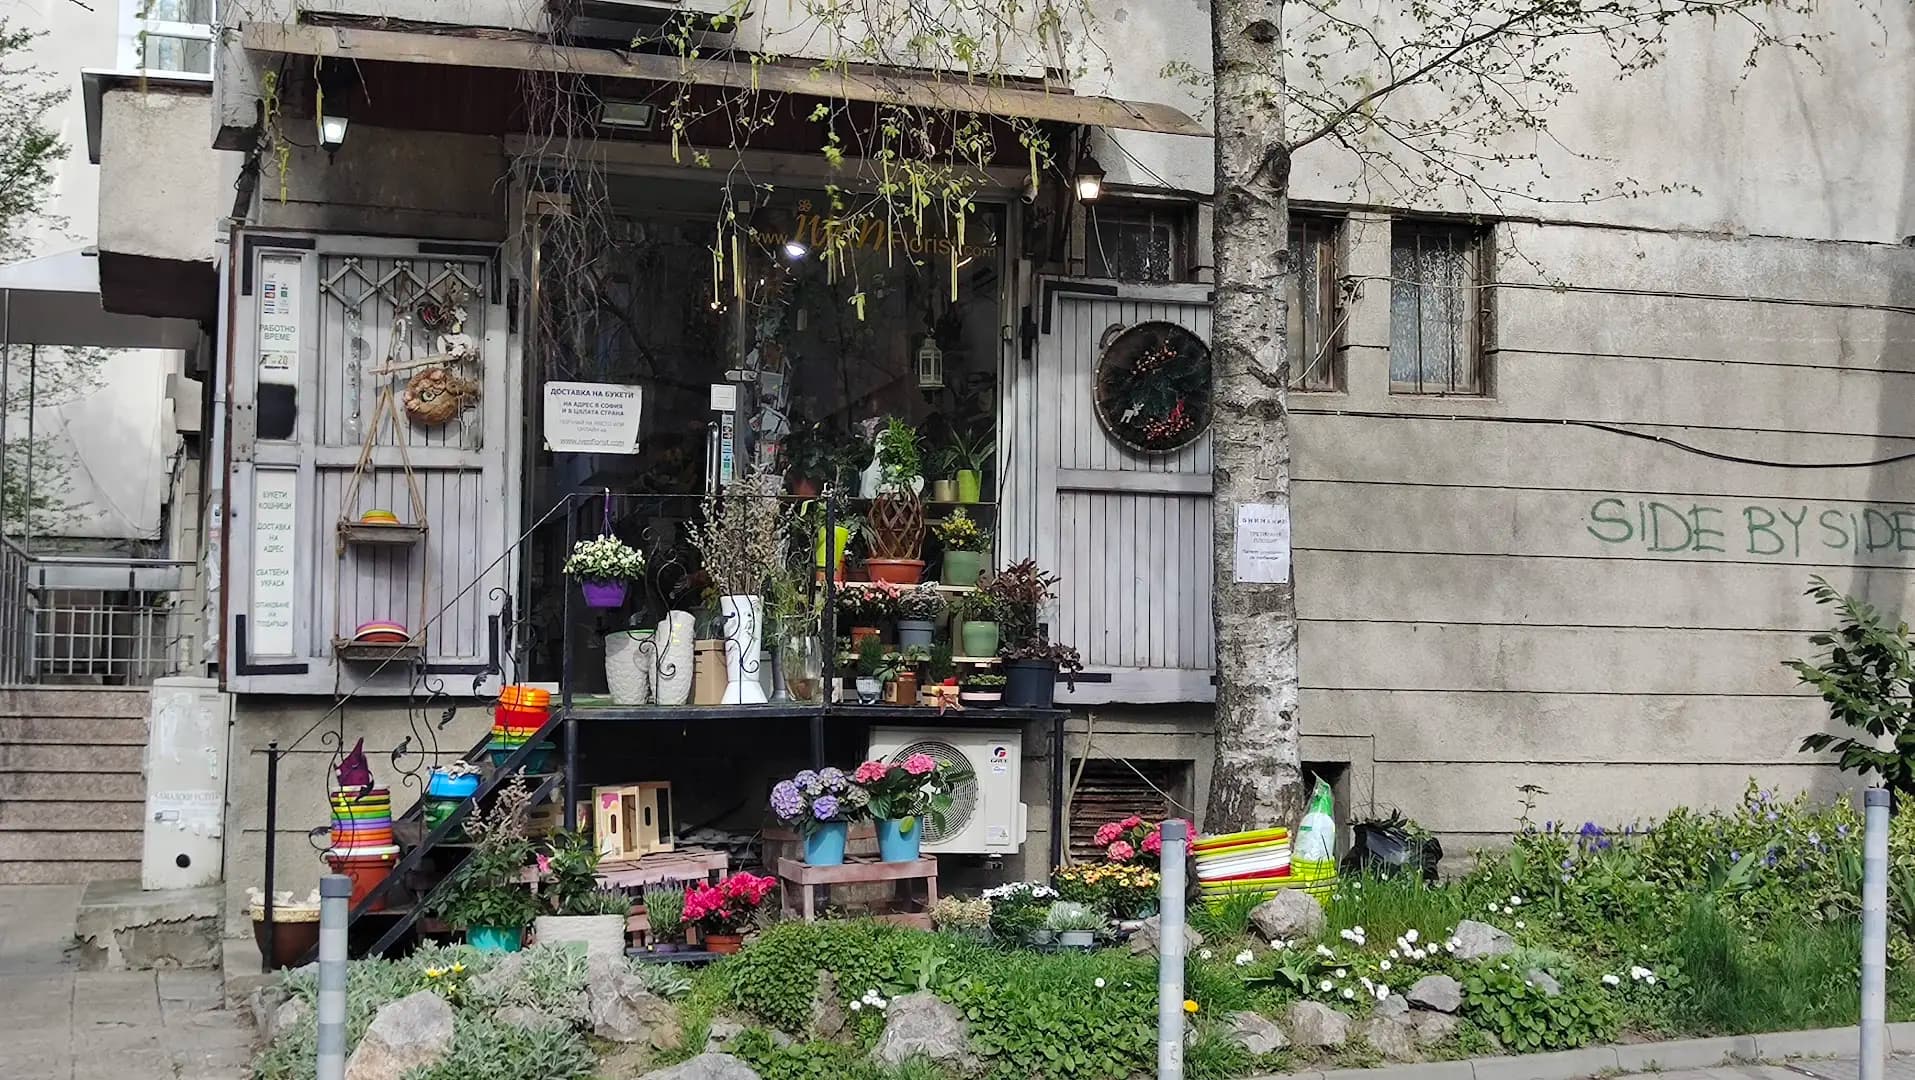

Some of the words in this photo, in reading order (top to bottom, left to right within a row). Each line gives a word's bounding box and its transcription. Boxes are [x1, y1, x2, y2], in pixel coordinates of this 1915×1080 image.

[259, 324, 296, 333] РАБОТНО
[264, 333, 290, 341] ВРЕМЕ
[550, 388, 591, 397] ДОСТАВКА
[605, 391, 634, 399] БУКЕТИ
[263, 490, 288, 499] БУКЕТИ
[259, 502, 292, 510] КОШНИЦИ
[257, 522, 291, 530] ДОСТАВКА
[1587, 498, 1725, 552] SIDE
[1743, 505, 1807, 557] BY
[1819, 509, 1915, 556] SIDE
[263, 545, 284, 553] АДРЕС
[256, 568, 289, 576] СВАТБЕНА
